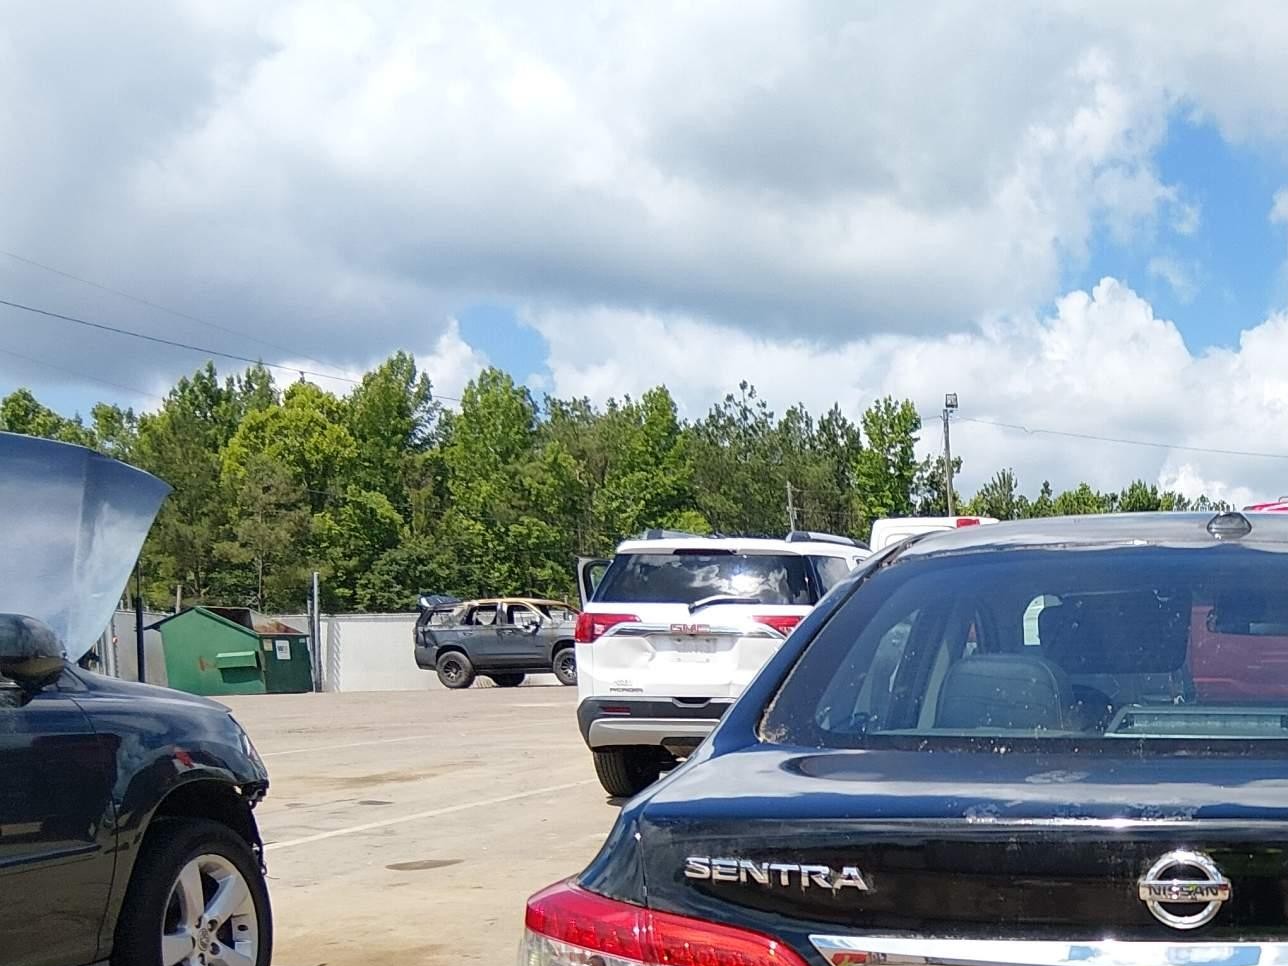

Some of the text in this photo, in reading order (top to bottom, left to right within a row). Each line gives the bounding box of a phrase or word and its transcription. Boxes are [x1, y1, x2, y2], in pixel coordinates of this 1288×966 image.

[670, 623, 711, 635] GMC
[684, 855, 869, 892] SENTRA
[1147, 885, 1219, 897] NISSAN
